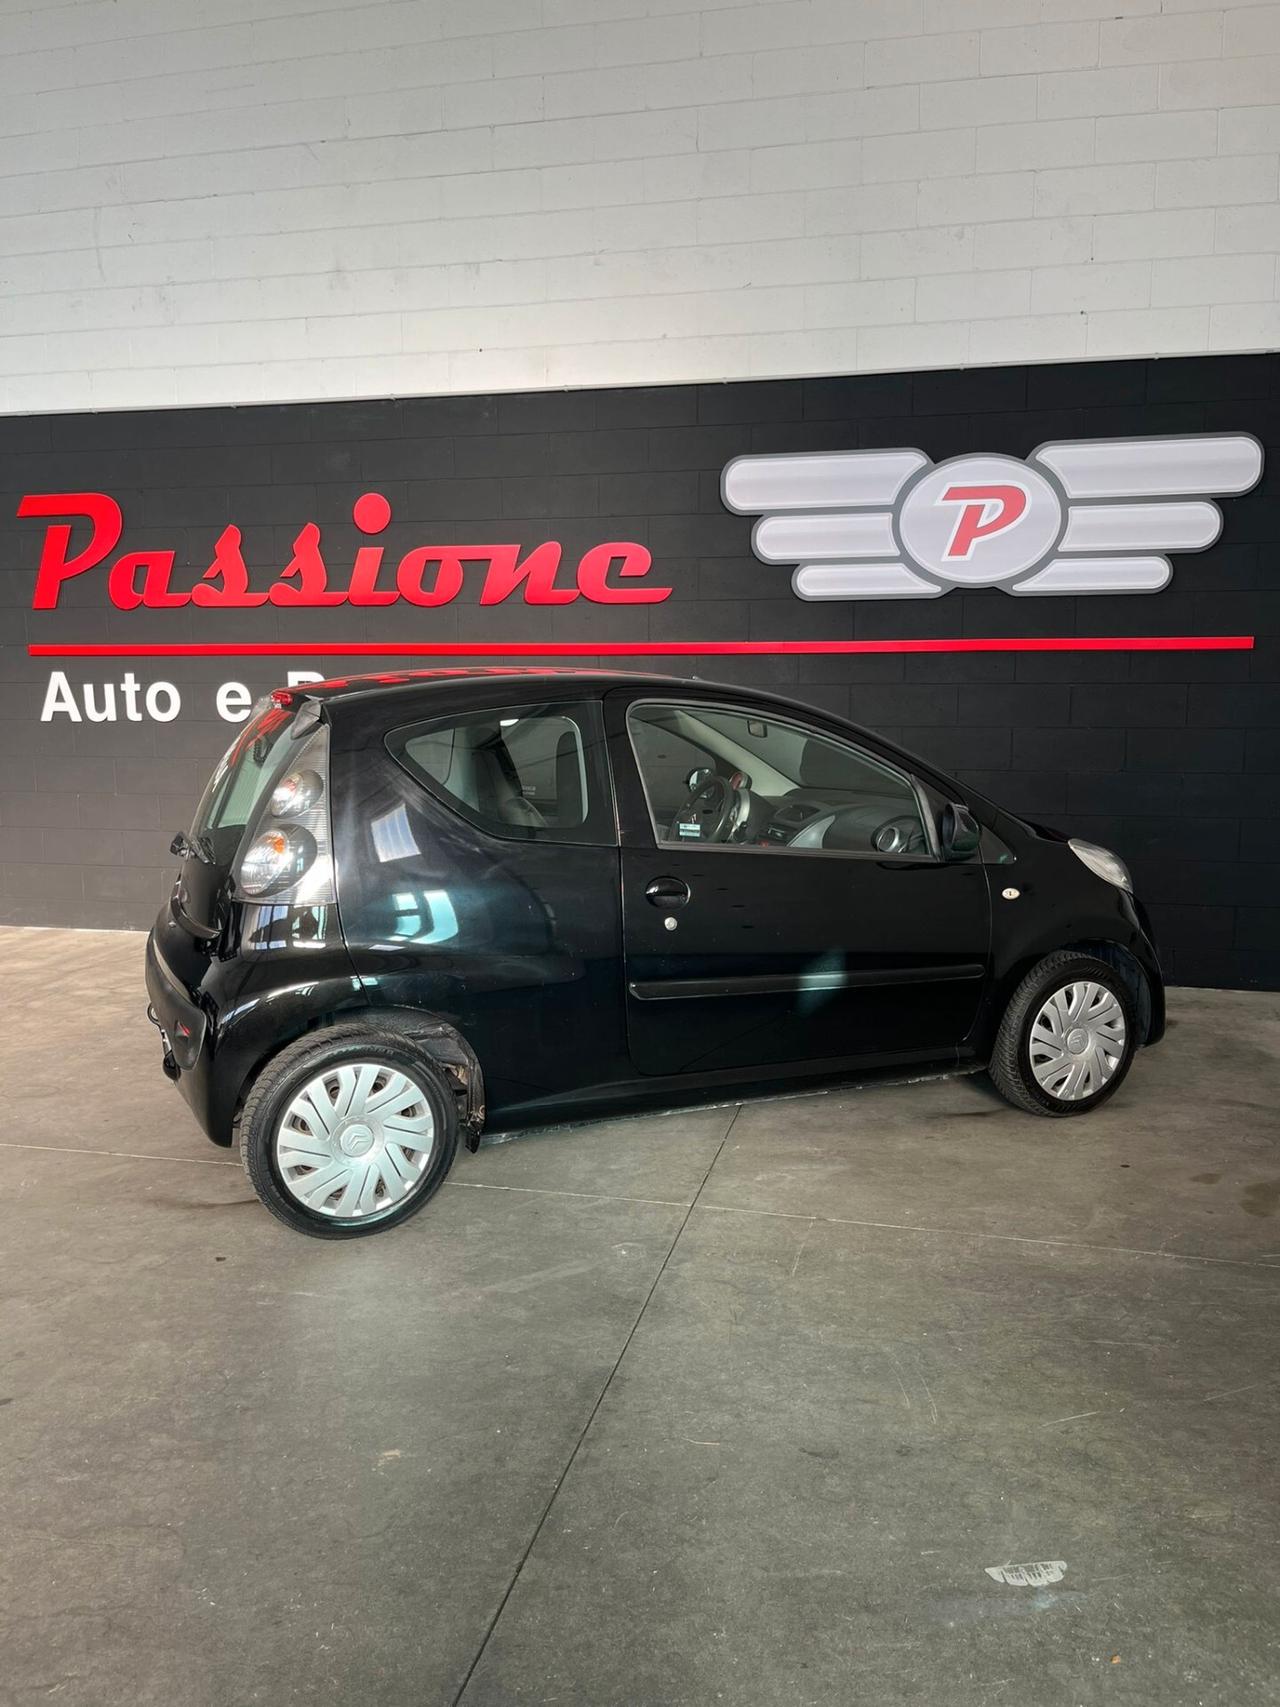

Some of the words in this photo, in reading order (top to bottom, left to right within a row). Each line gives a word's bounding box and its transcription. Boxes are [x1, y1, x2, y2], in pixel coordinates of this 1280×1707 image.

[17, 492, 672, 611] Passione
[942, 485, 1027, 558] P
[40, 671, 182, 723] Auto
[215, 681, 253, 723] e
